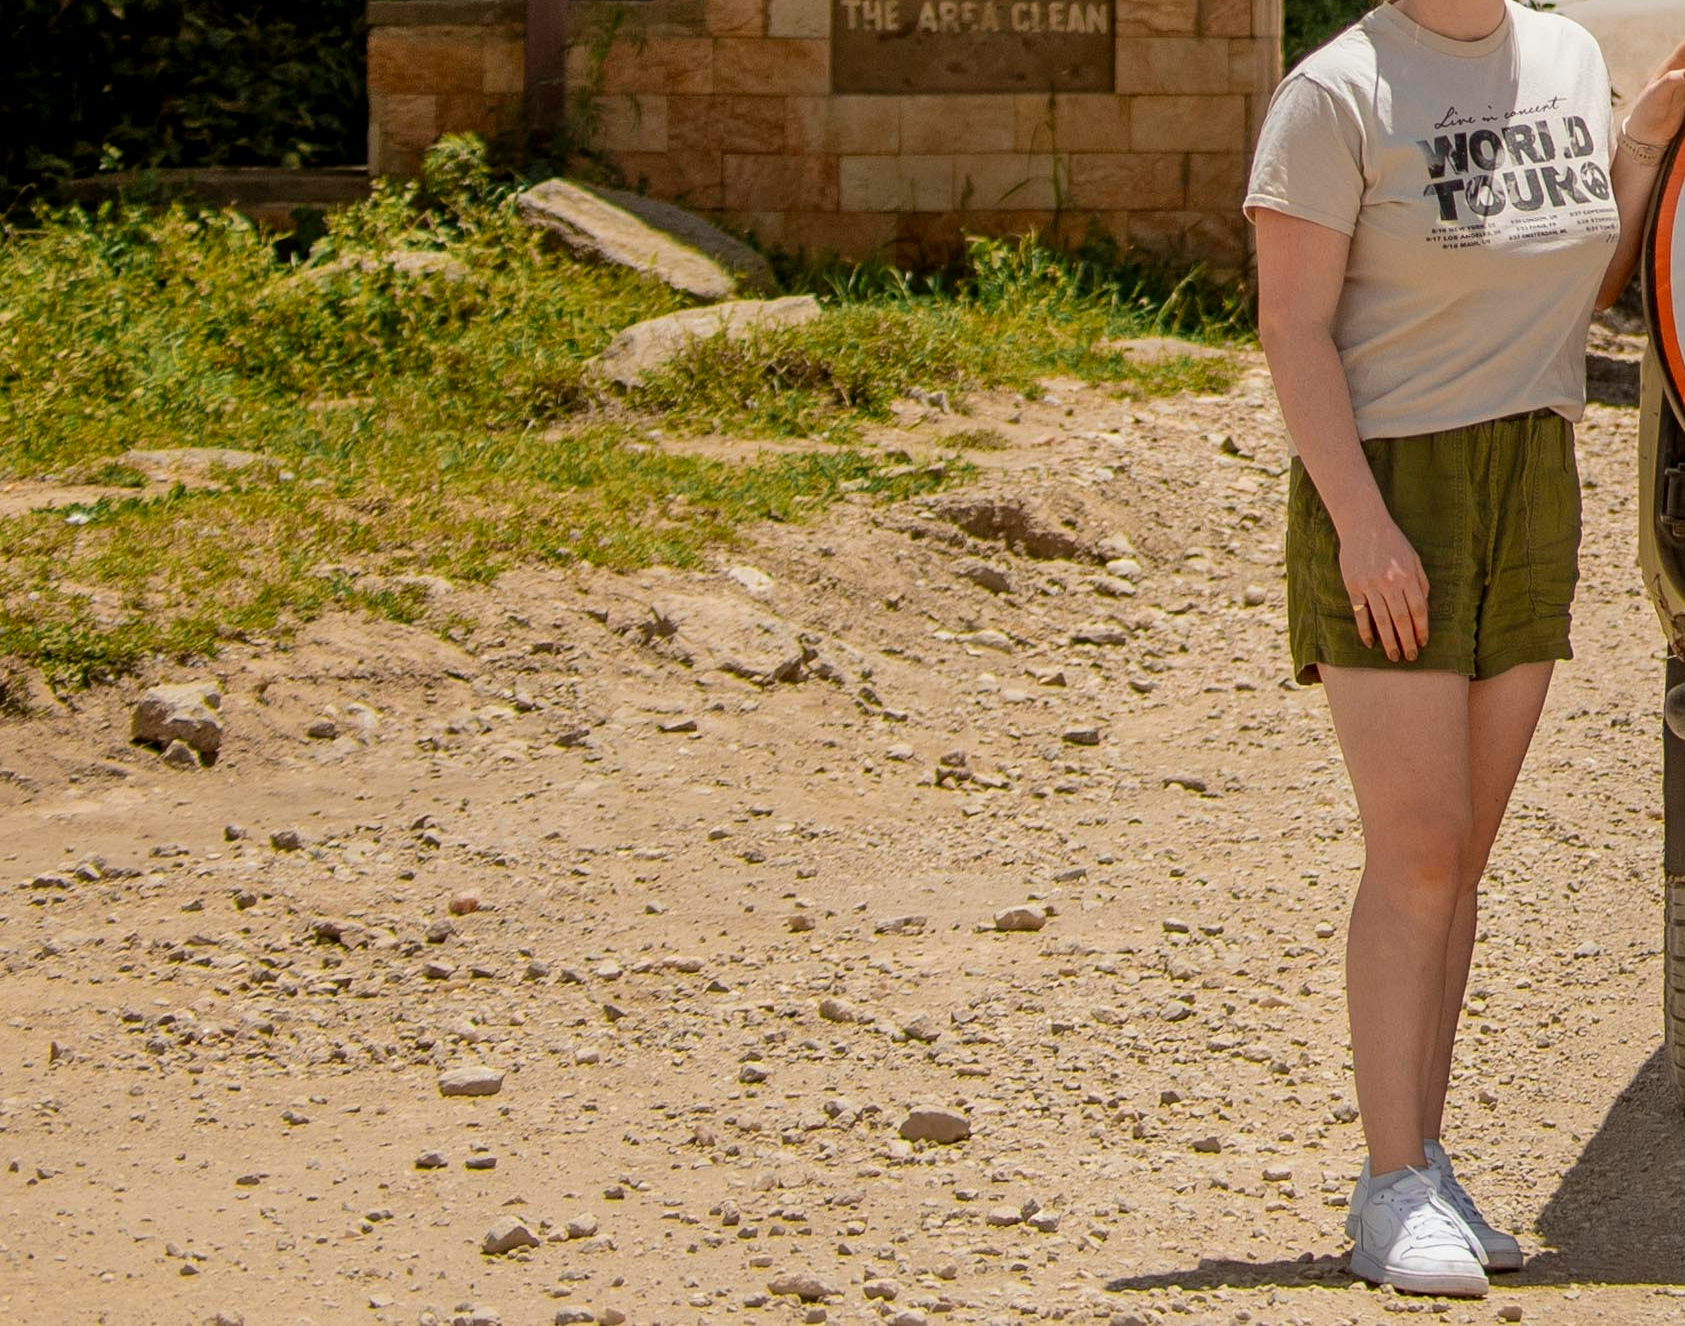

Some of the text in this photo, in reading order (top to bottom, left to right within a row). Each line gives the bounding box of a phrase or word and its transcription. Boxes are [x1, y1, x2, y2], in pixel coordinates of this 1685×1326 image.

[840, 0, 1109, 34] THE AREA CLEAN
[1434, 96, 1567, 129] Live in concert
[1416, 115, 1594, 179] WORLD
